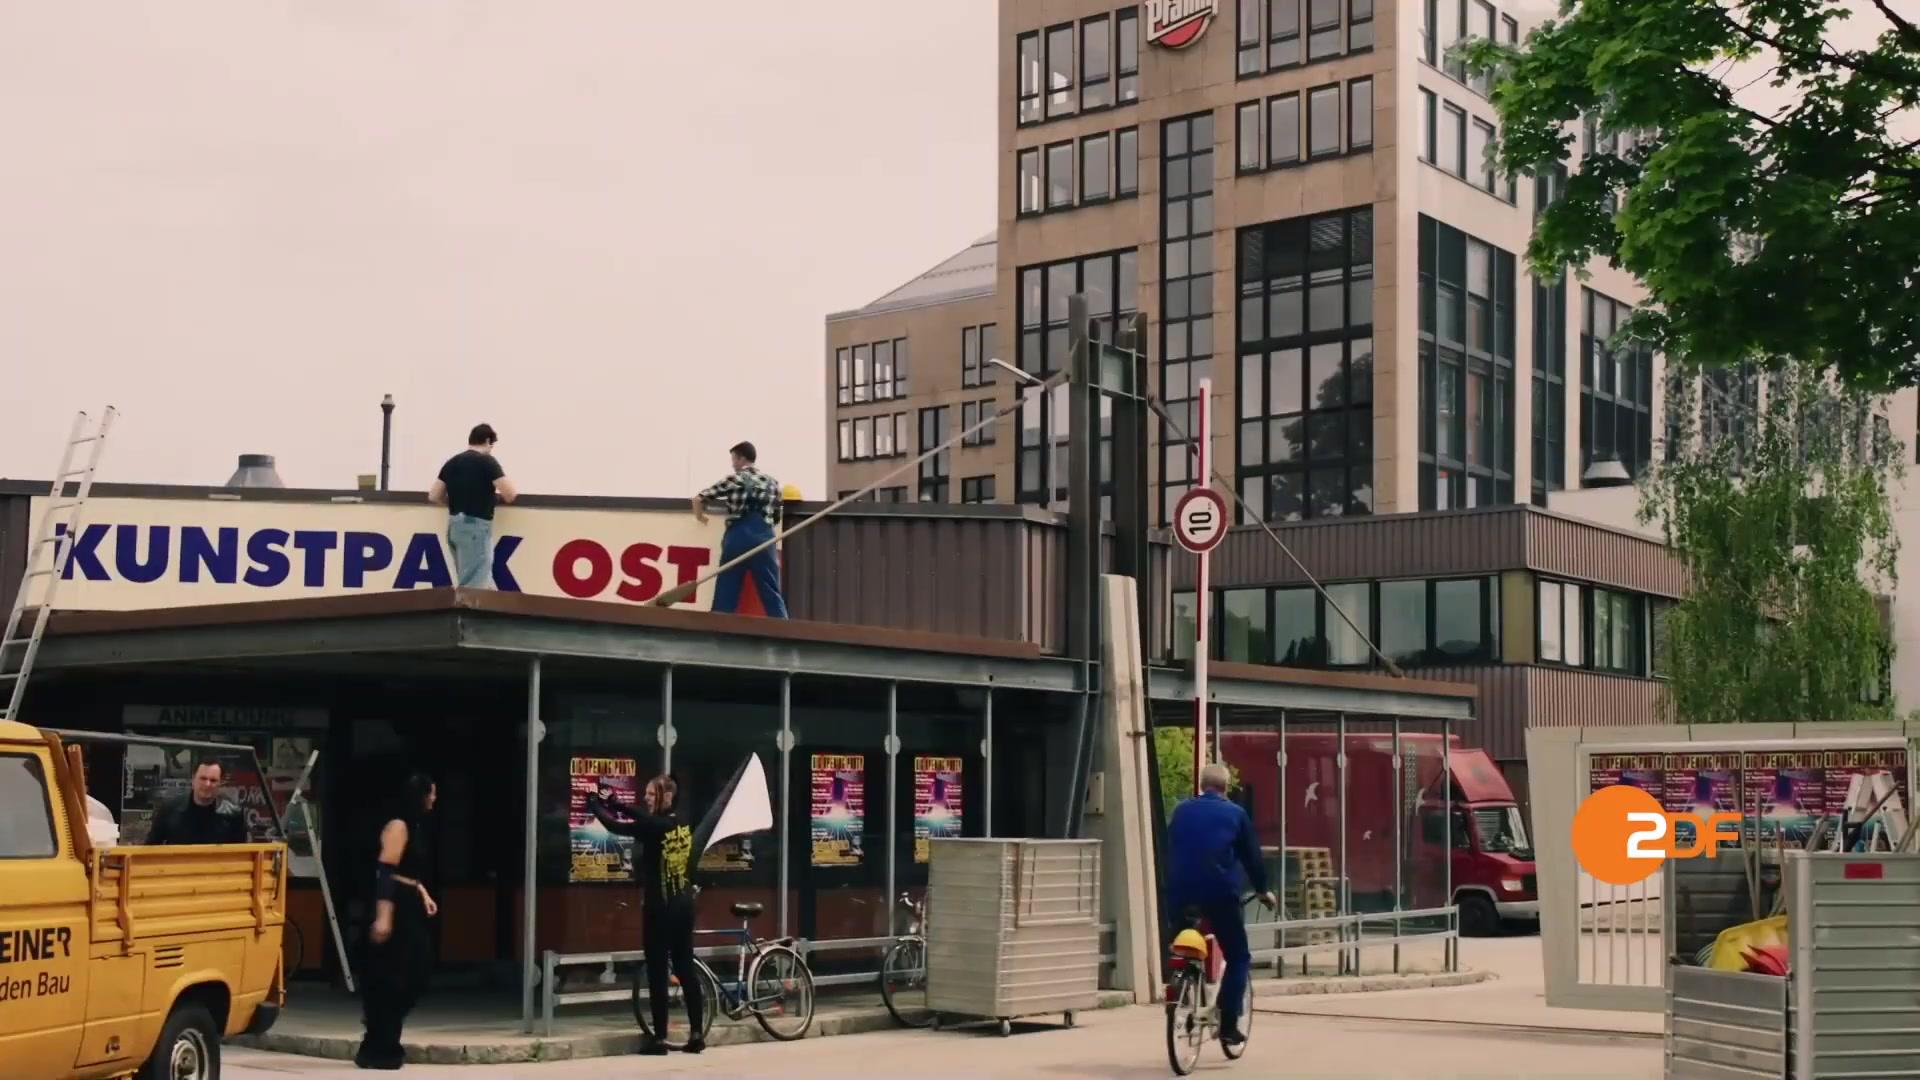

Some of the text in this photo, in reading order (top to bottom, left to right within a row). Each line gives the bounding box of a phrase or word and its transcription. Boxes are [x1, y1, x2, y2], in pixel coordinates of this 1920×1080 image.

[1189, 511, 1212, 536] 10
[54, 523, 710, 603] KUNSTPAK OST
[0, 927, 71, 964] EINER
[0, 972, 70, 1002] den Bau
